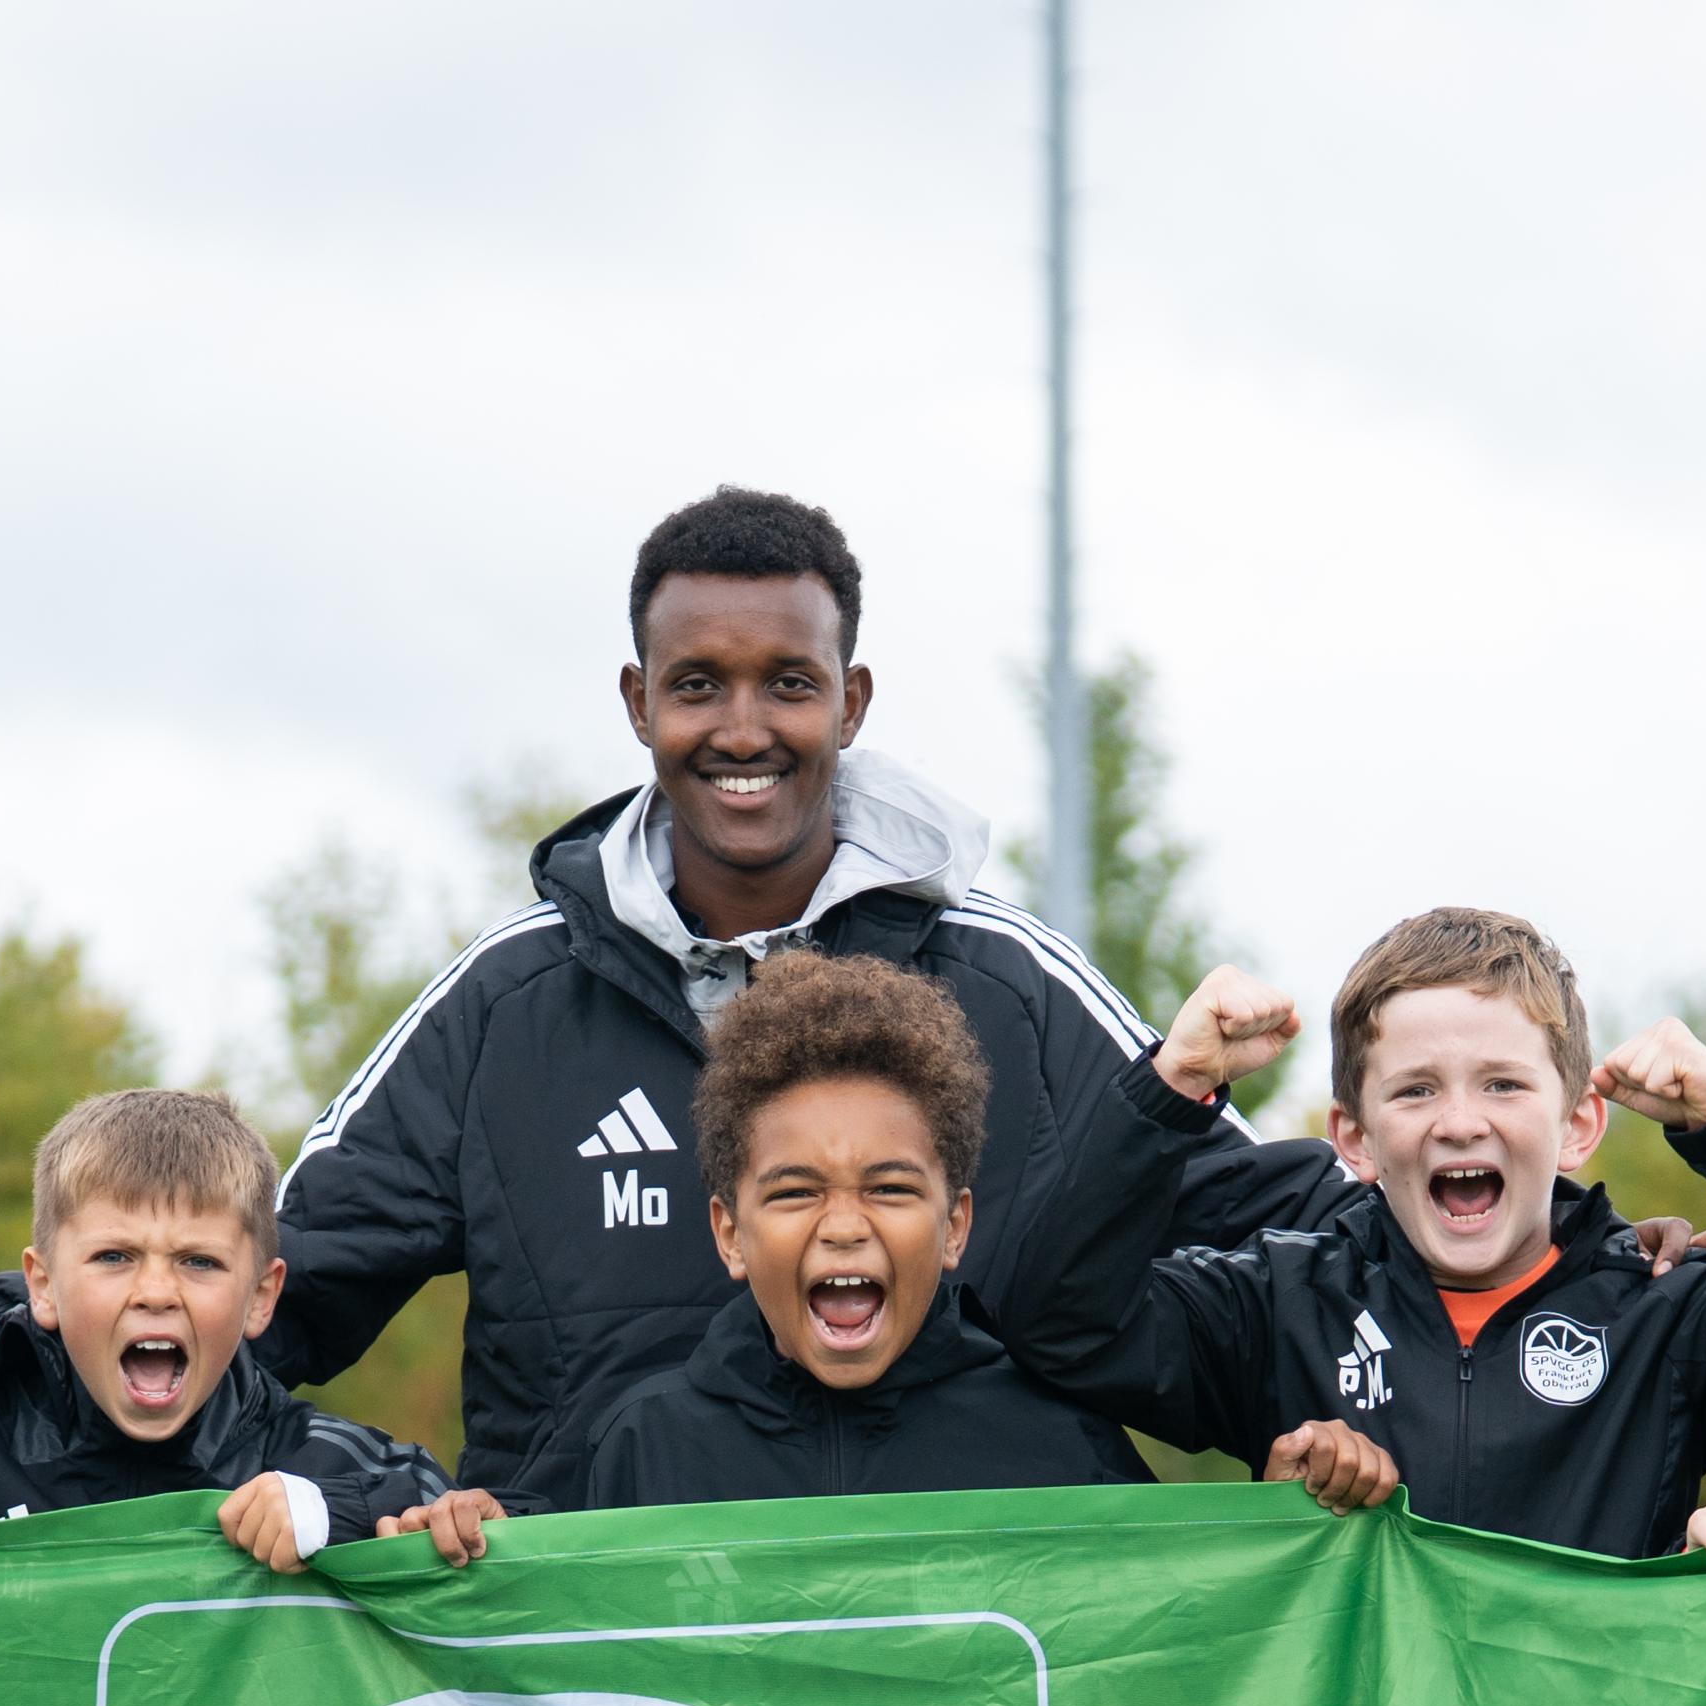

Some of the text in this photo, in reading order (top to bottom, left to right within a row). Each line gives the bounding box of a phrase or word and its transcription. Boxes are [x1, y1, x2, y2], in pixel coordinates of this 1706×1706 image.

[603, 1169, 668, 1228] Mo
[1582, 1355, 1597, 1368] 05
[1538, 1368, 1593, 1381] Frankfurt
[1542, 1378, 1589, 1390] Oberrad
